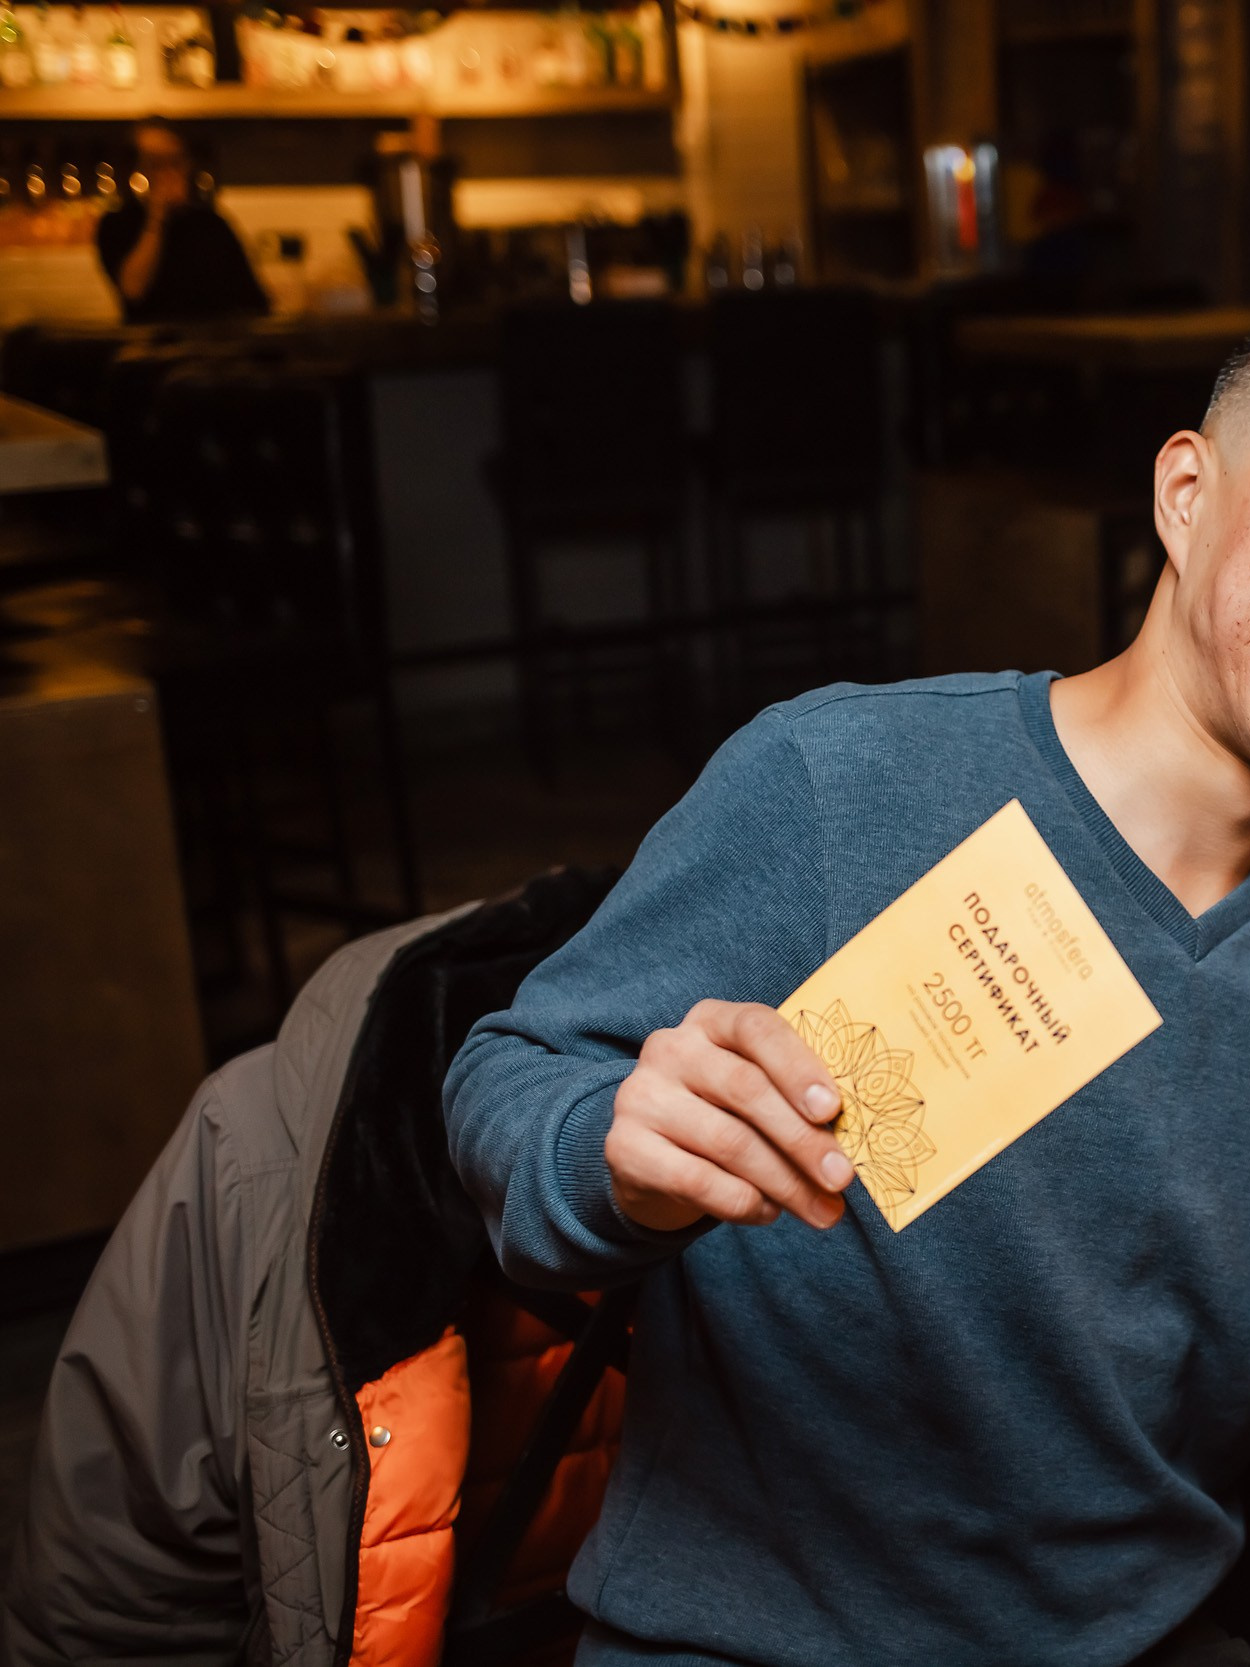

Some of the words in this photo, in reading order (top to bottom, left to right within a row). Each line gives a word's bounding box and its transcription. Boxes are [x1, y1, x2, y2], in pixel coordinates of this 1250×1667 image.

[923, 971, 972, 1036] 2500
[948, 923, 1040, 1054] СЕРТИФИКАТ
[964, 891, 1072, 1045] ПОДАРОЧНЫЙ
